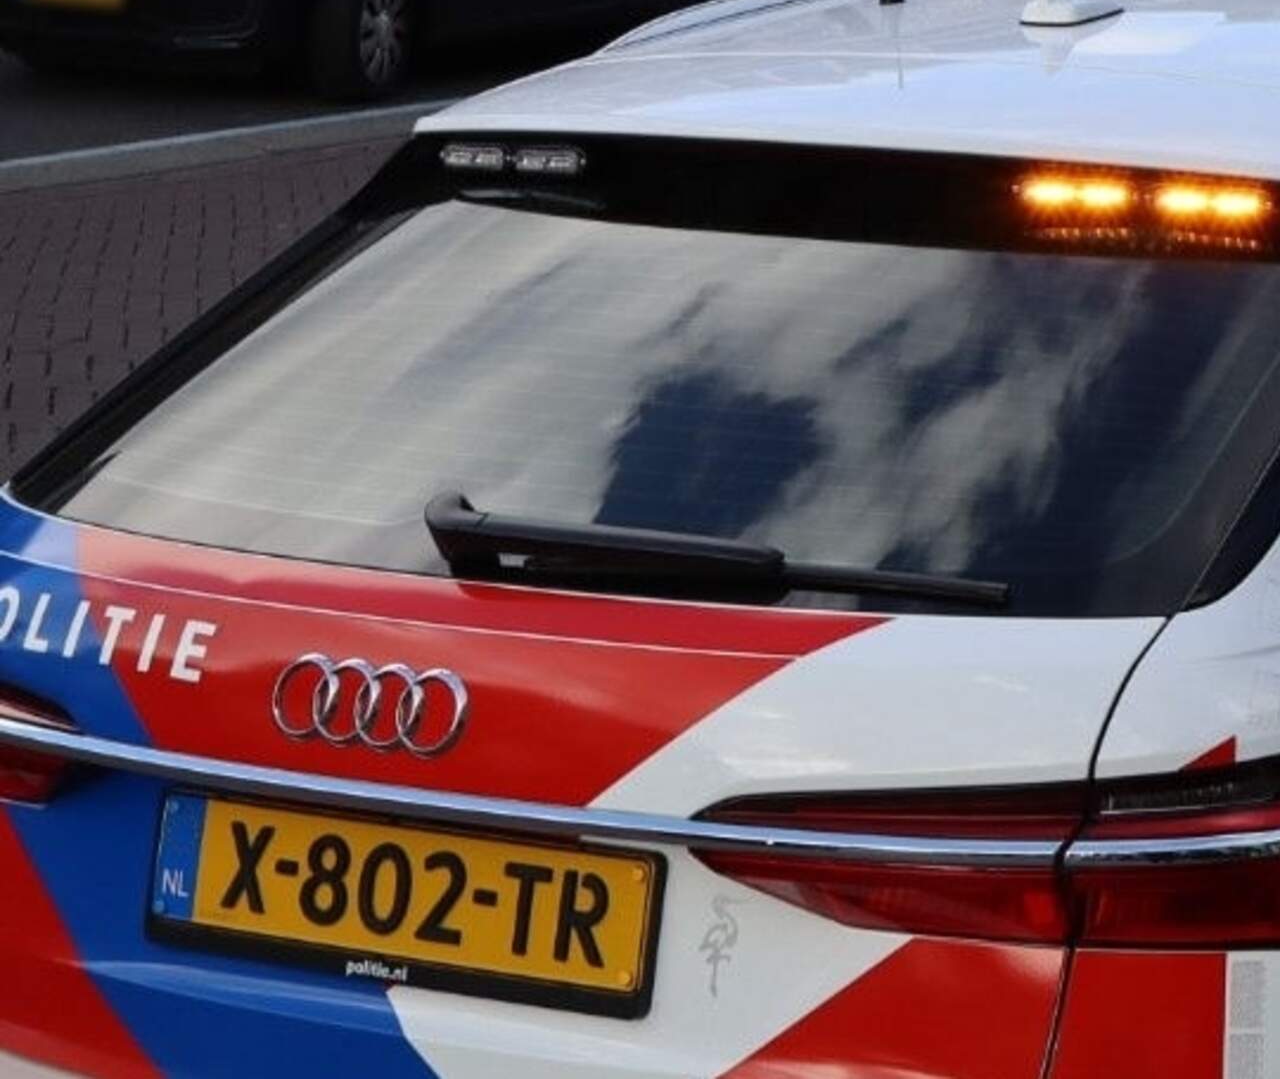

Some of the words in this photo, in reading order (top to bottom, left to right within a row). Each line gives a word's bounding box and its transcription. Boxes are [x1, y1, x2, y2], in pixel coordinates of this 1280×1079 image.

[163, 869, 189, 897] NL
[220, 821, 610, 968] X-802-TR
[345, 959, 408, 983] politie.nl
